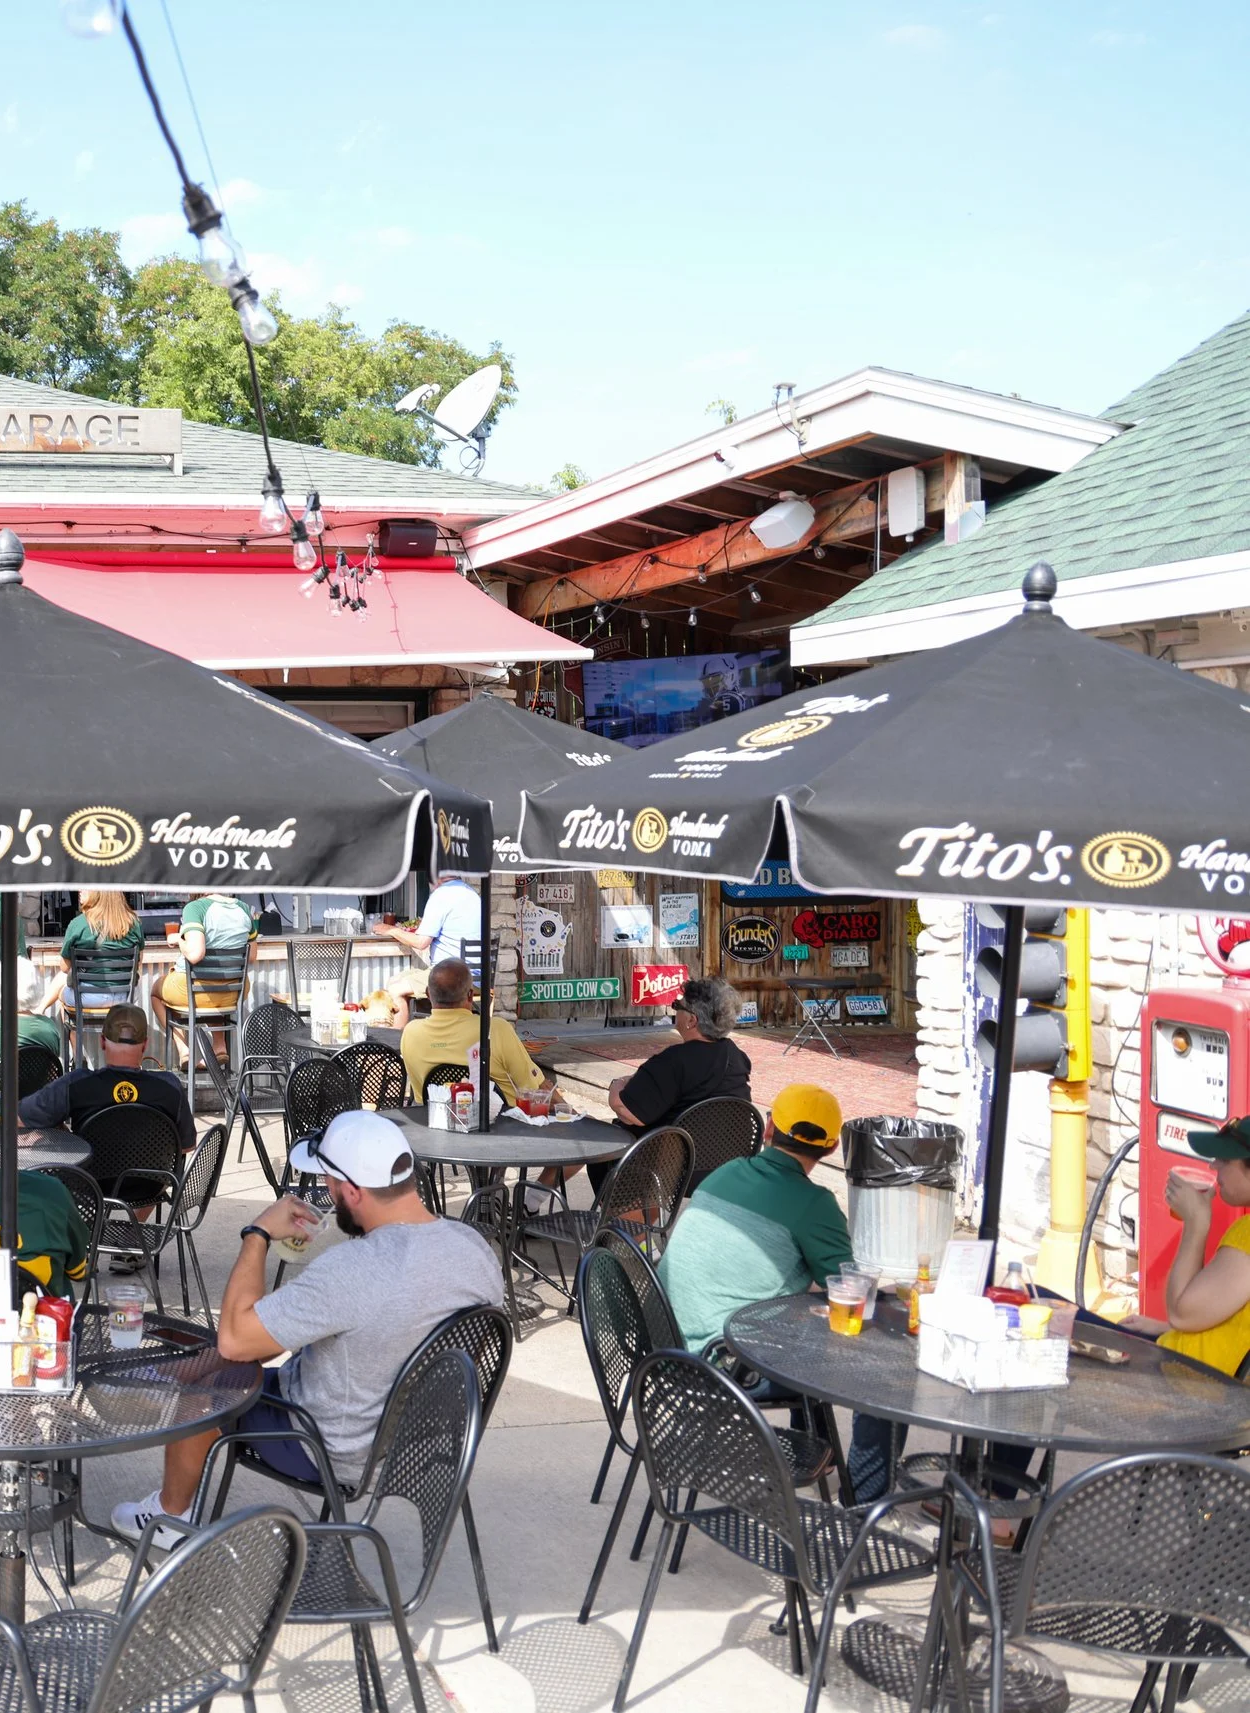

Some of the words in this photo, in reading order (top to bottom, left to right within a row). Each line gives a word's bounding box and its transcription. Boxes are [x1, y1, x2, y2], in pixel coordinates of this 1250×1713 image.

[722, 698, 731, 712] 5
[149, 812, 297, 849] Handmade
[672, 839, 711, 858] VODKA
[170, 848, 273, 871] VODKA
[539, 888, 550, 899] 87
[553, 888, 569, 899] 418
[823, 914, 877, 928] CABO
[728, 924, 775, 951] Founders
[823, 928, 878, 940] DIABLO
[531, 983, 574, 999] SPOTTED
[578, 981, 598, 997] COW
[634, 968, 684, 1004] Potosi
[1164, 1124, 1187, 1141] FIRE
